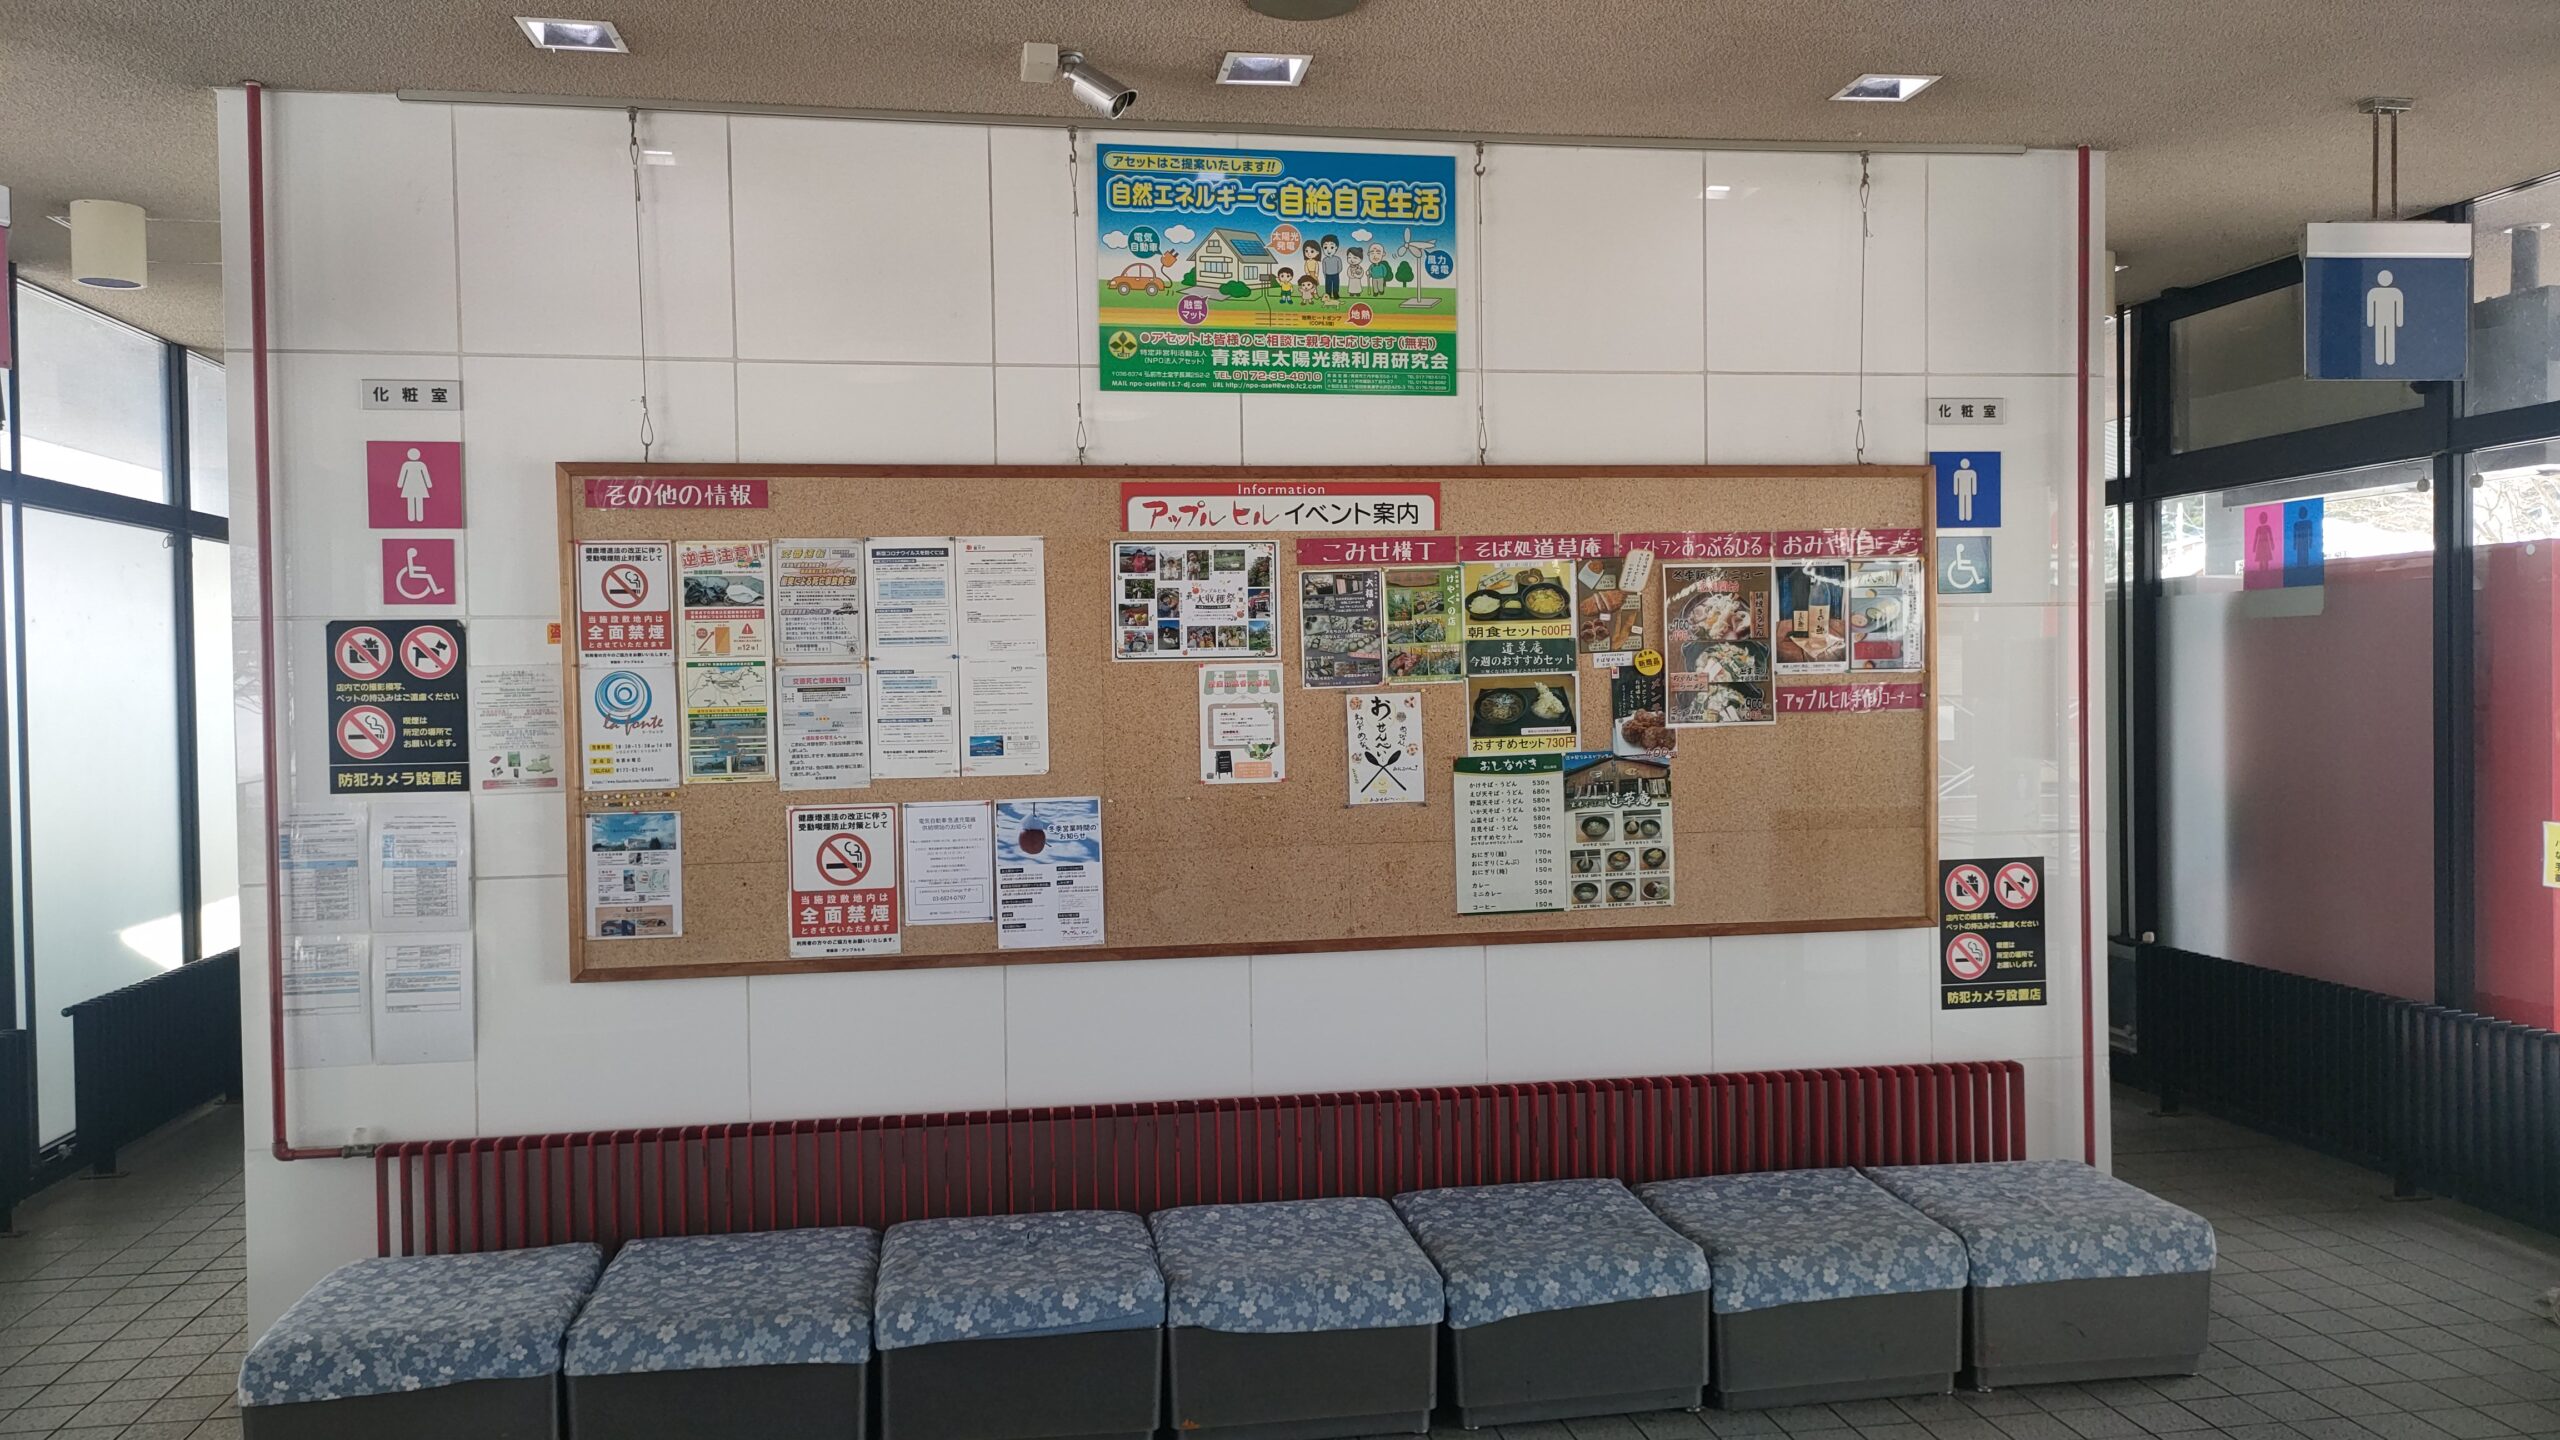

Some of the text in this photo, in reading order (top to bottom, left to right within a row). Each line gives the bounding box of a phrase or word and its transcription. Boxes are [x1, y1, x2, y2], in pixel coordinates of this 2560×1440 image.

[1112, 156, 1276, 172] アセットはご提案いたします!!
[1112, 180, 1441, 220] 自然エネルギーで自給自足生活
[1133, 233, 1153, 242] 電気
[1272, 232, 1299, 242] 太陽光
[1130, 242, 1159, 252] 自動車
[1277, 241, 1296, 251] 発電
[1427, 255, 1447, 266] 風力
[1430, 265, 1449, 275] 発電
[1183, 300, 1203, 310] 融雪
[1181, 310, 1206, 320] マット
[1351, 309, 1370, 320] 地熱
[1140, 349, 1207, 357] 特定非営利活動法人
[1211, 349, 1448, 370] 青森県太陽光熱利用研究会
[1213, 370, 1231, 380] TEL
[373, 387, 448, 403] 化粧室
[1938, 404, 1996, 419] 化粧室
[606, 484, 752, 506] その他の情報
[1237, 484, 1326, 495] Information
[1285, 502, 1419, 526] イベント案内
[1322, 541, 1437, 562] こみせ横丁
[1475, 539, 1601, 558] そば処道草庵
[682, 544, 765, 569] 逆走注意!!
[588, 615, 663, 624] 当施設敷地内は
[588, 625, 665, 640] 全面禁煙
[1468, 624, 1571, 638] 朝食セット600円
[1502, 641, 1543, 655] 道草庵
[1470, 654, 1574, 667] 今週のおすすめセット
[336, 693, 460, 703] ペットの持込みはご遠慮ください
[403, 716, 427, 725] 喫煙は
[403, 728, 452, 737] 所定の場所で
[403, 739, 457, 748] お願いします。
[1473, 737, 1576, 751] おすすめセット730円
[1480, 758, 1537, 771] おしながき
[338, 771, 462, 787] 防犯カメラ設置店
[798, 812, 887, 822] 健康増進法の改正に伴う
[798, 821, 887, 831] 受動喫煙防止対策として
[1049, 824, 1097, 834] 冬季営業時間の
[1060, 832, 1086, 840] お知らせ
[801, 893, 888, 905] 当施設敷地内は
[800, 905, 889, 925] 全面禁煙
[801, 924, 889, 935] とさせていただきます
[1997, 961, 2037, 969] お願いします。
[1947, 988, 2041, 1004] 防犯カメラ設置店
